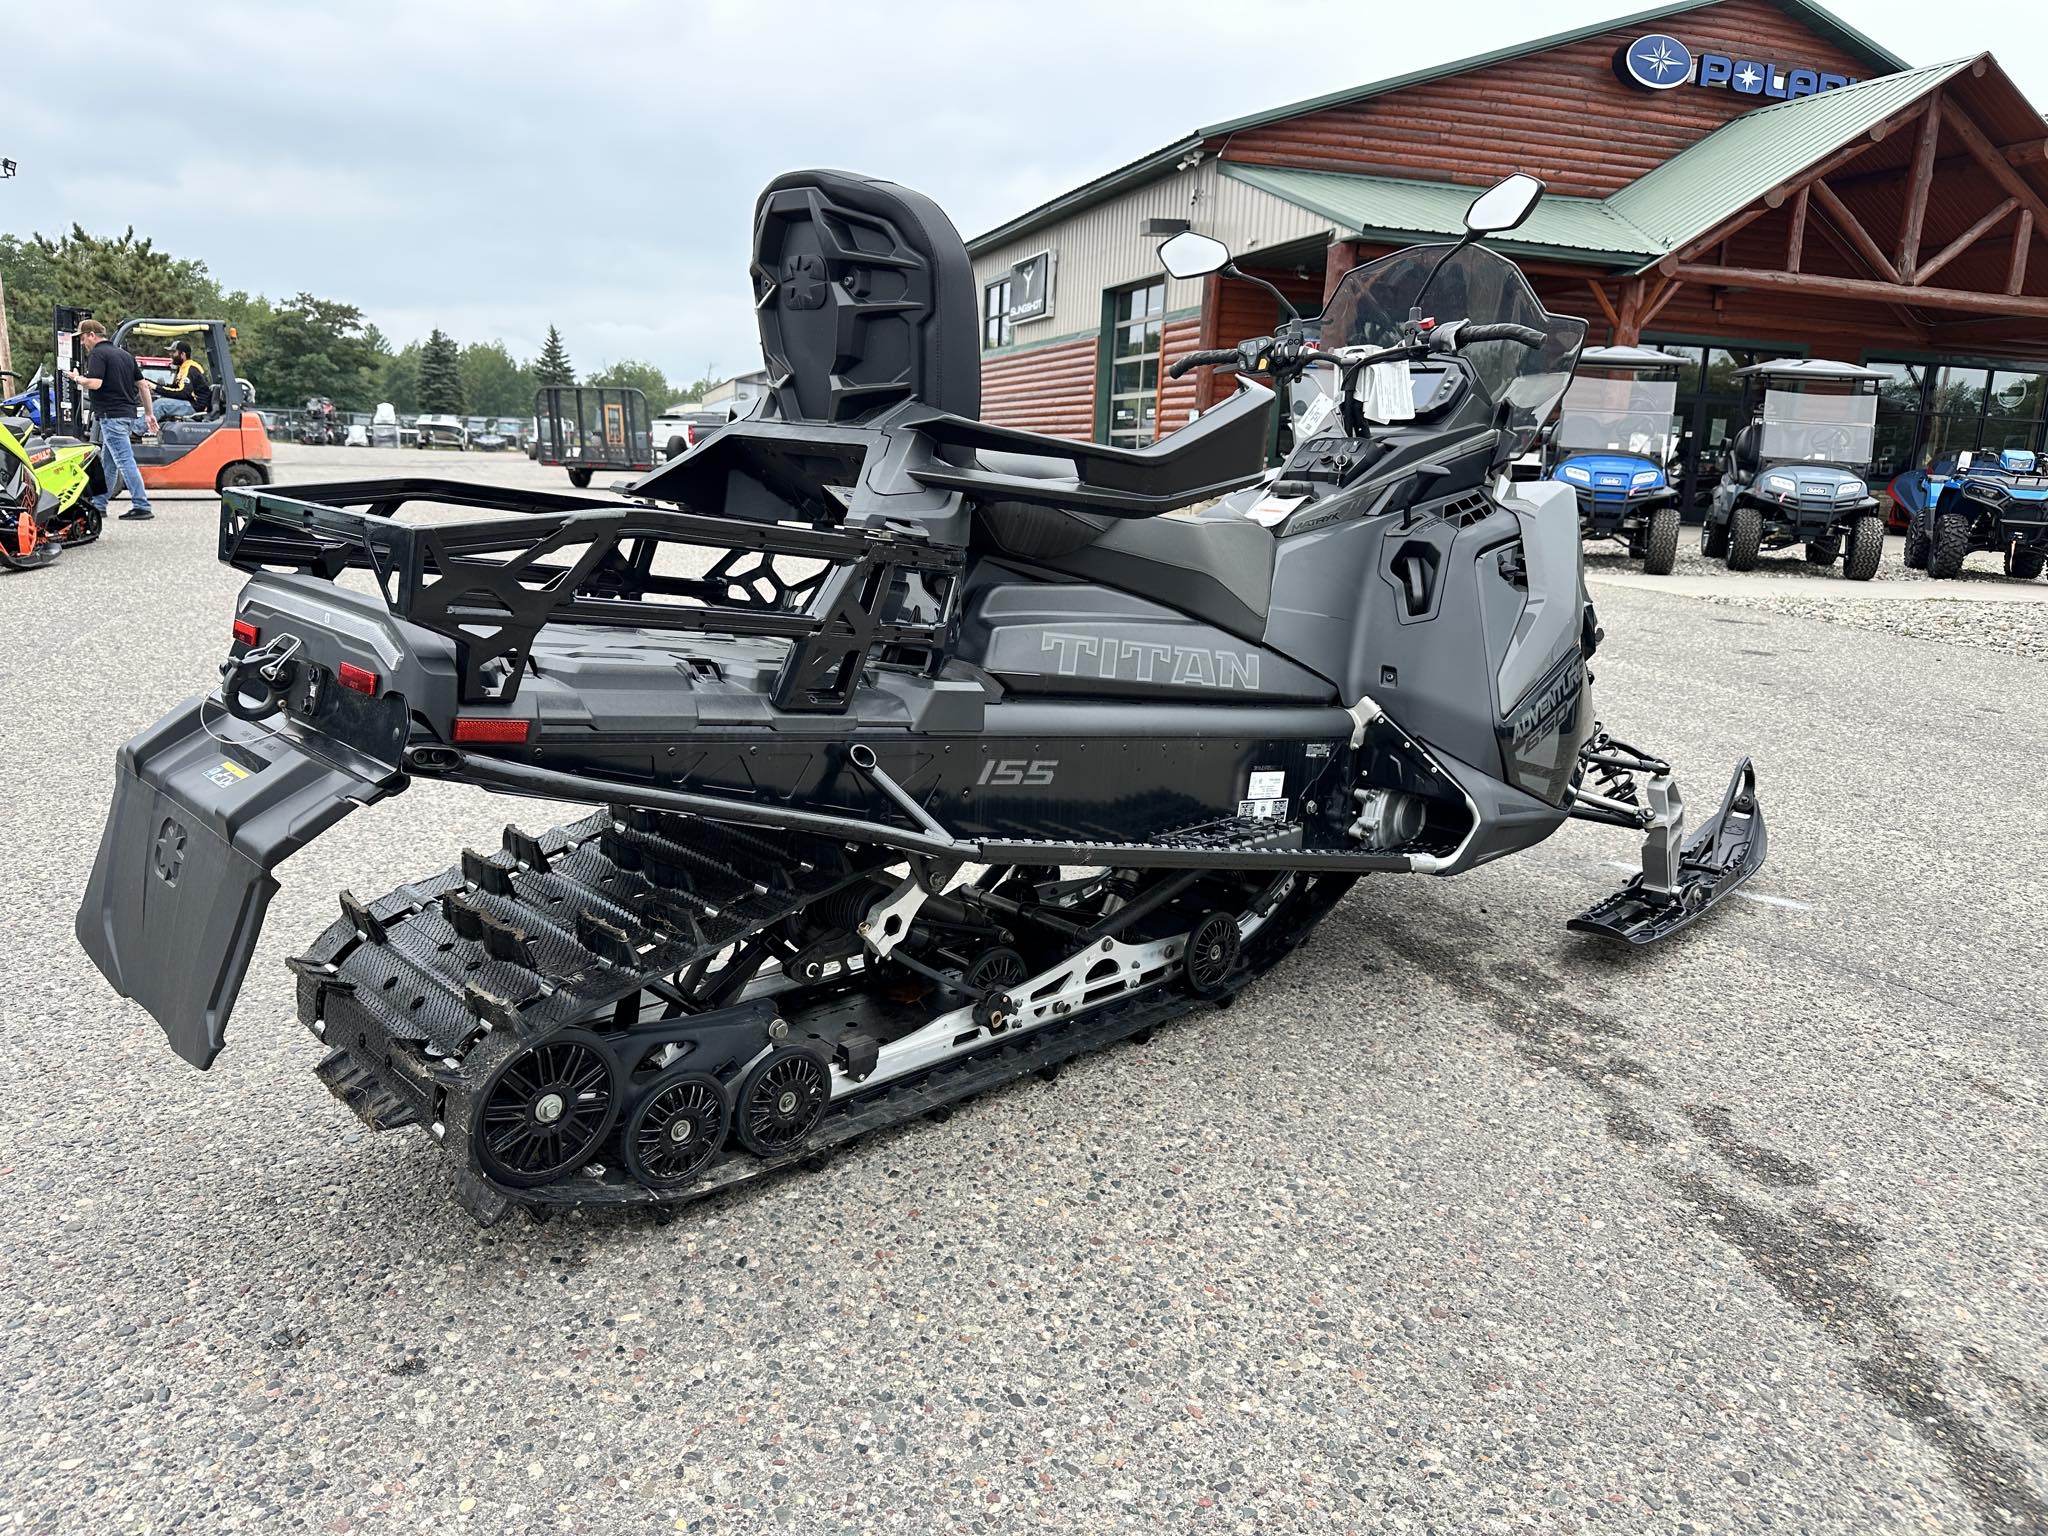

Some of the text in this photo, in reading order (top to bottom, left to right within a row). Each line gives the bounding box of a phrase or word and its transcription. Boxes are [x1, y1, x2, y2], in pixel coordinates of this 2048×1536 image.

[1291, 511, 1340, 533] MATRYX
[1041, 631, 1260, 690] TITAN
[976, 759, 1059, 785] 155
